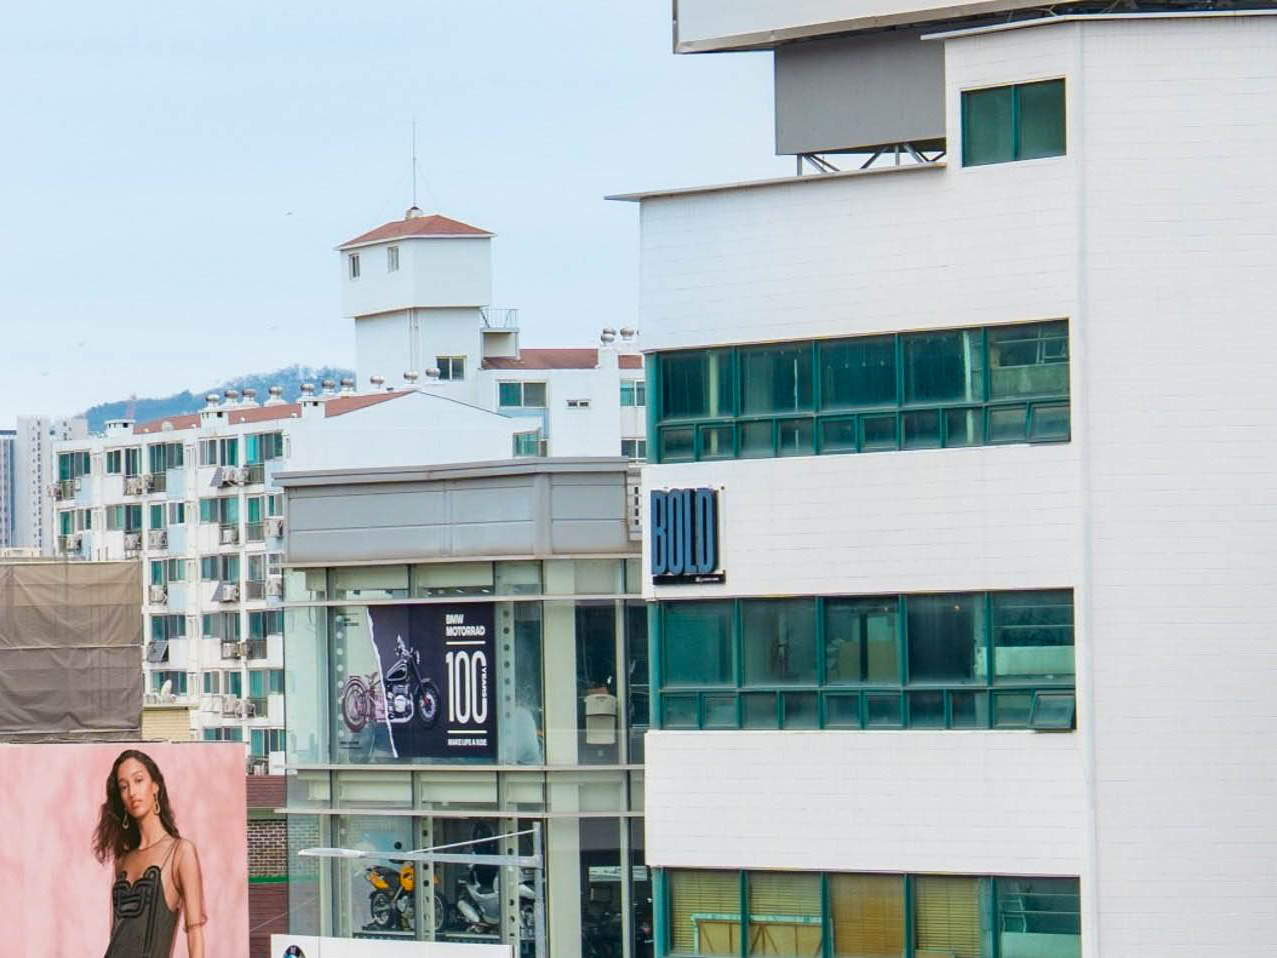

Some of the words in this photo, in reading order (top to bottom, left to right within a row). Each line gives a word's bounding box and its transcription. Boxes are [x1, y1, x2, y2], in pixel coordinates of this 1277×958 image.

[650, 488, 717, 575] BOLD
[445, 614, 464, 625] BMW
[445, 625, 486, 637] MOTORRAD
[445, 650, 488, 724] 100
